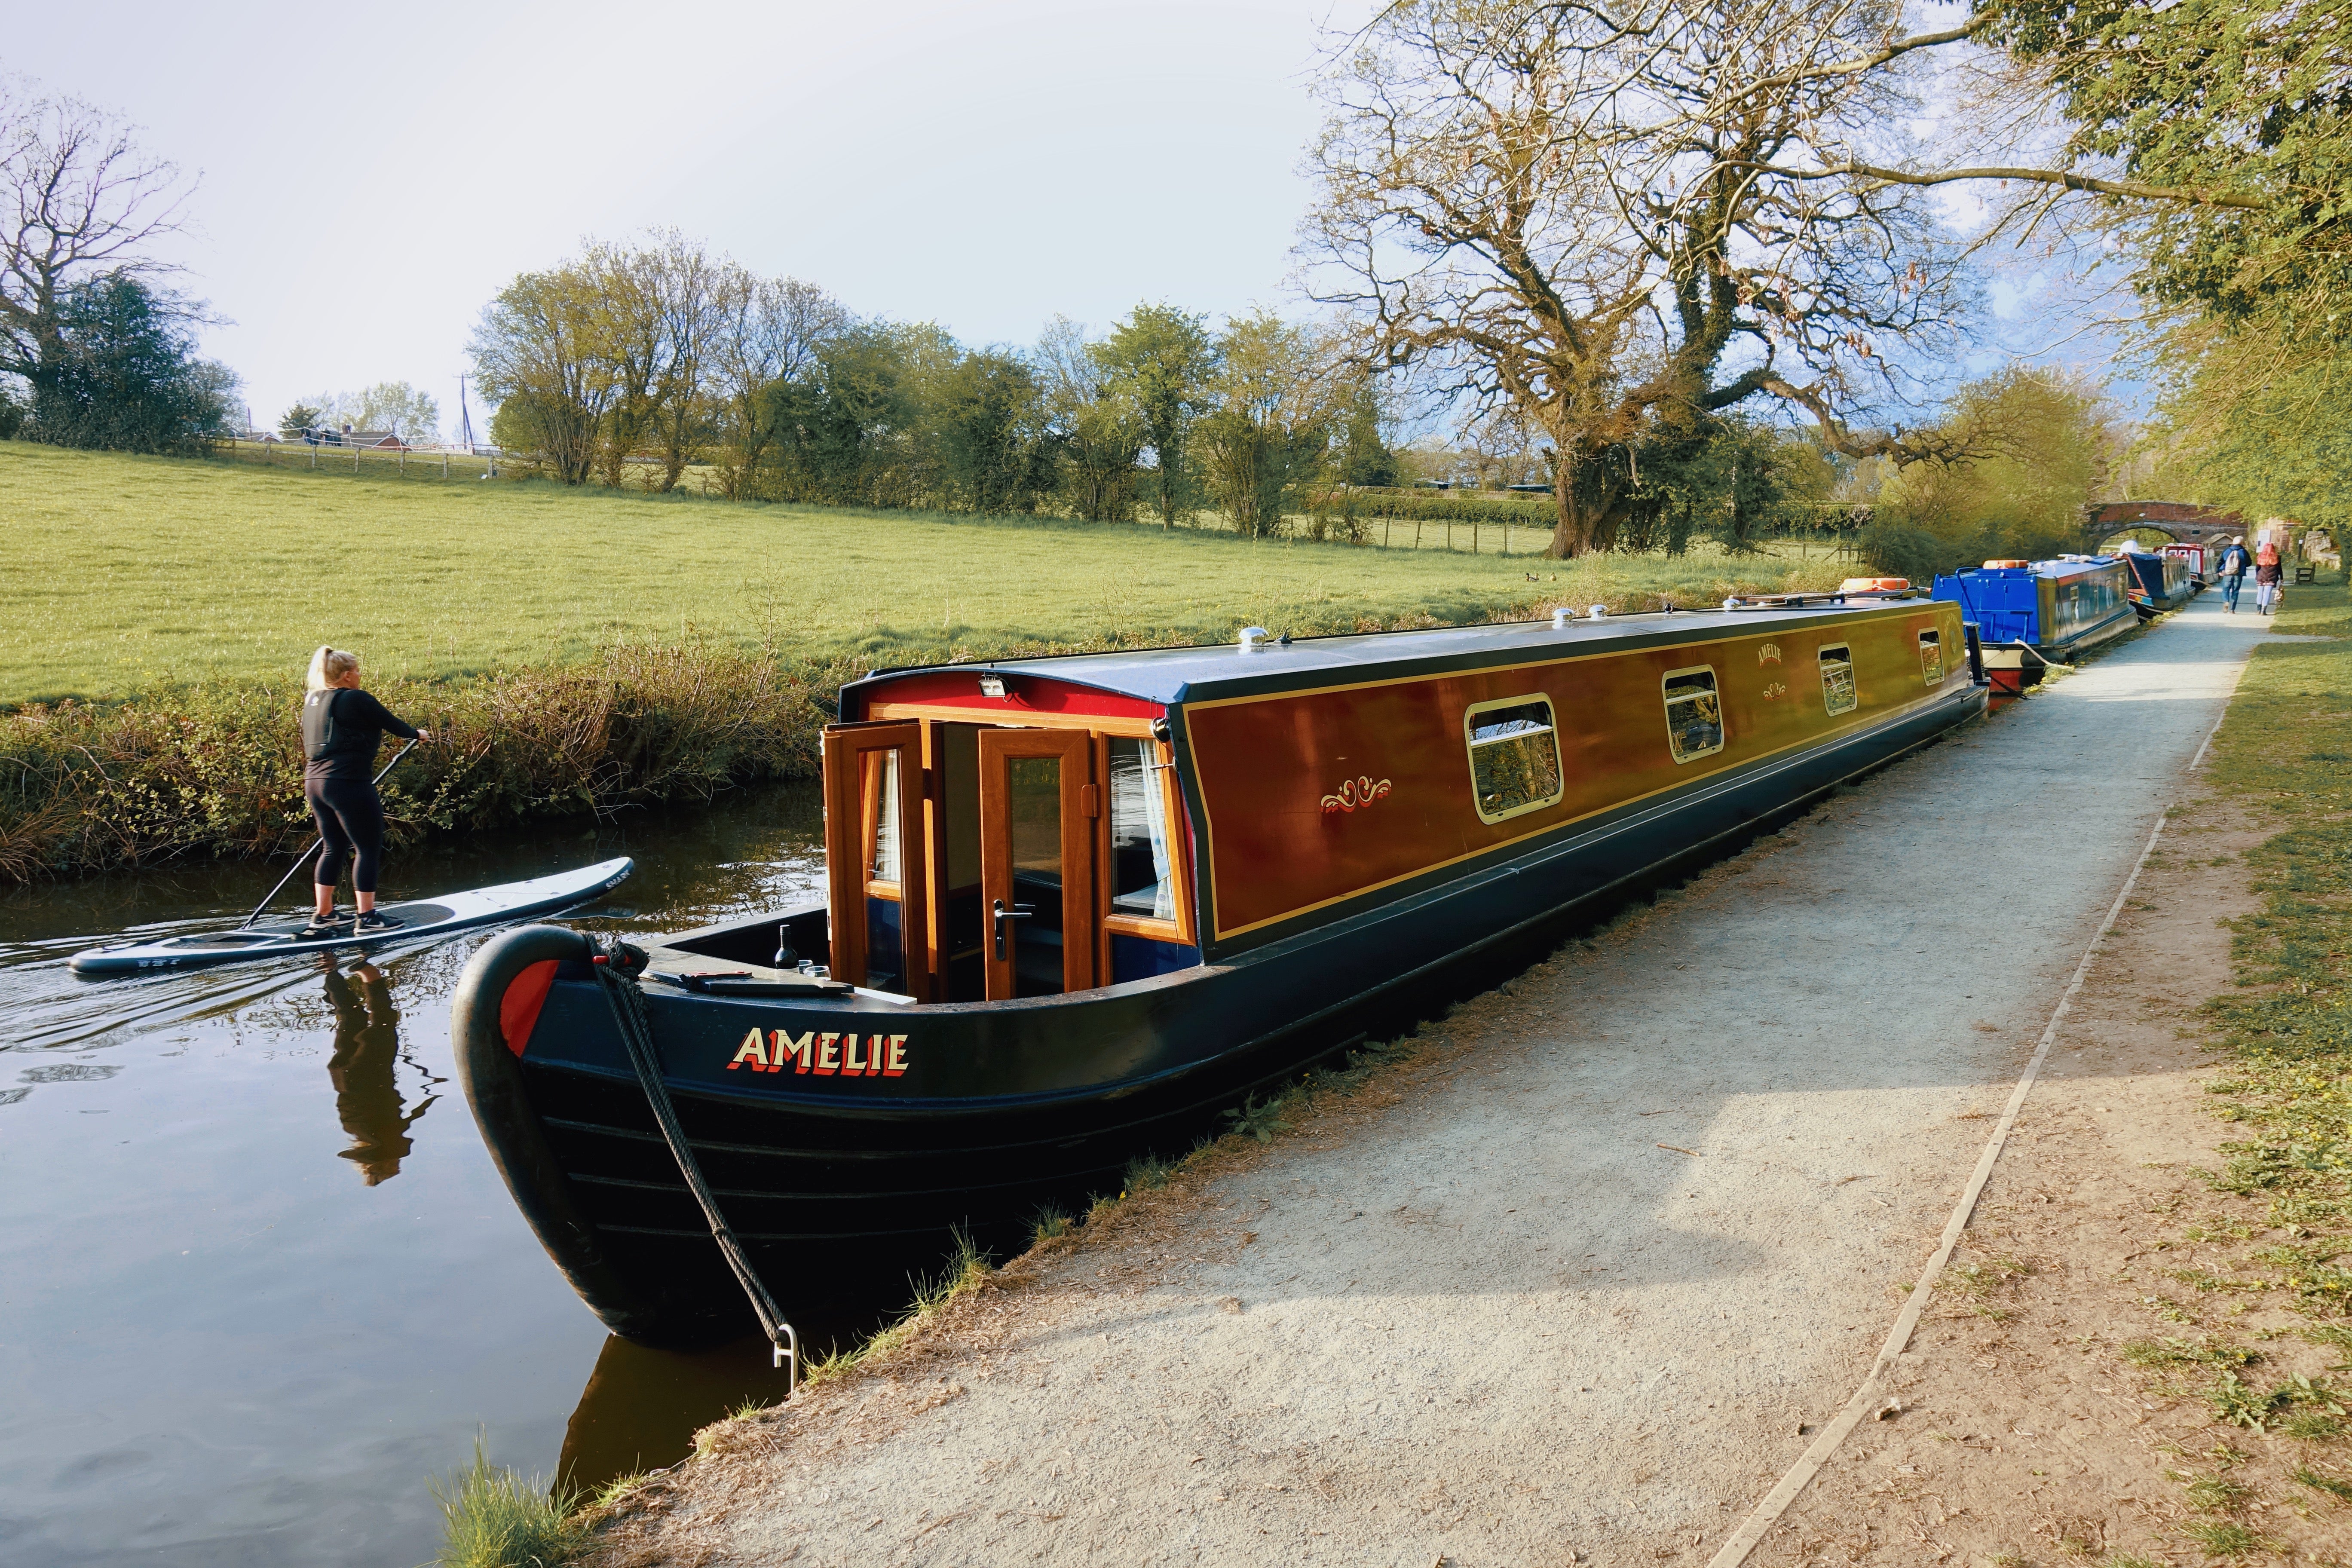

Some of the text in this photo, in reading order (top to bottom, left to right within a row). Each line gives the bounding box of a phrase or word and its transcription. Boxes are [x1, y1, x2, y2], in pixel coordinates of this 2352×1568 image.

[1758, 643, 1781, 667] AMELIE
[605, 869, 630, 890] SHARK
[727, 1027, 909, 1076] AMELIE
